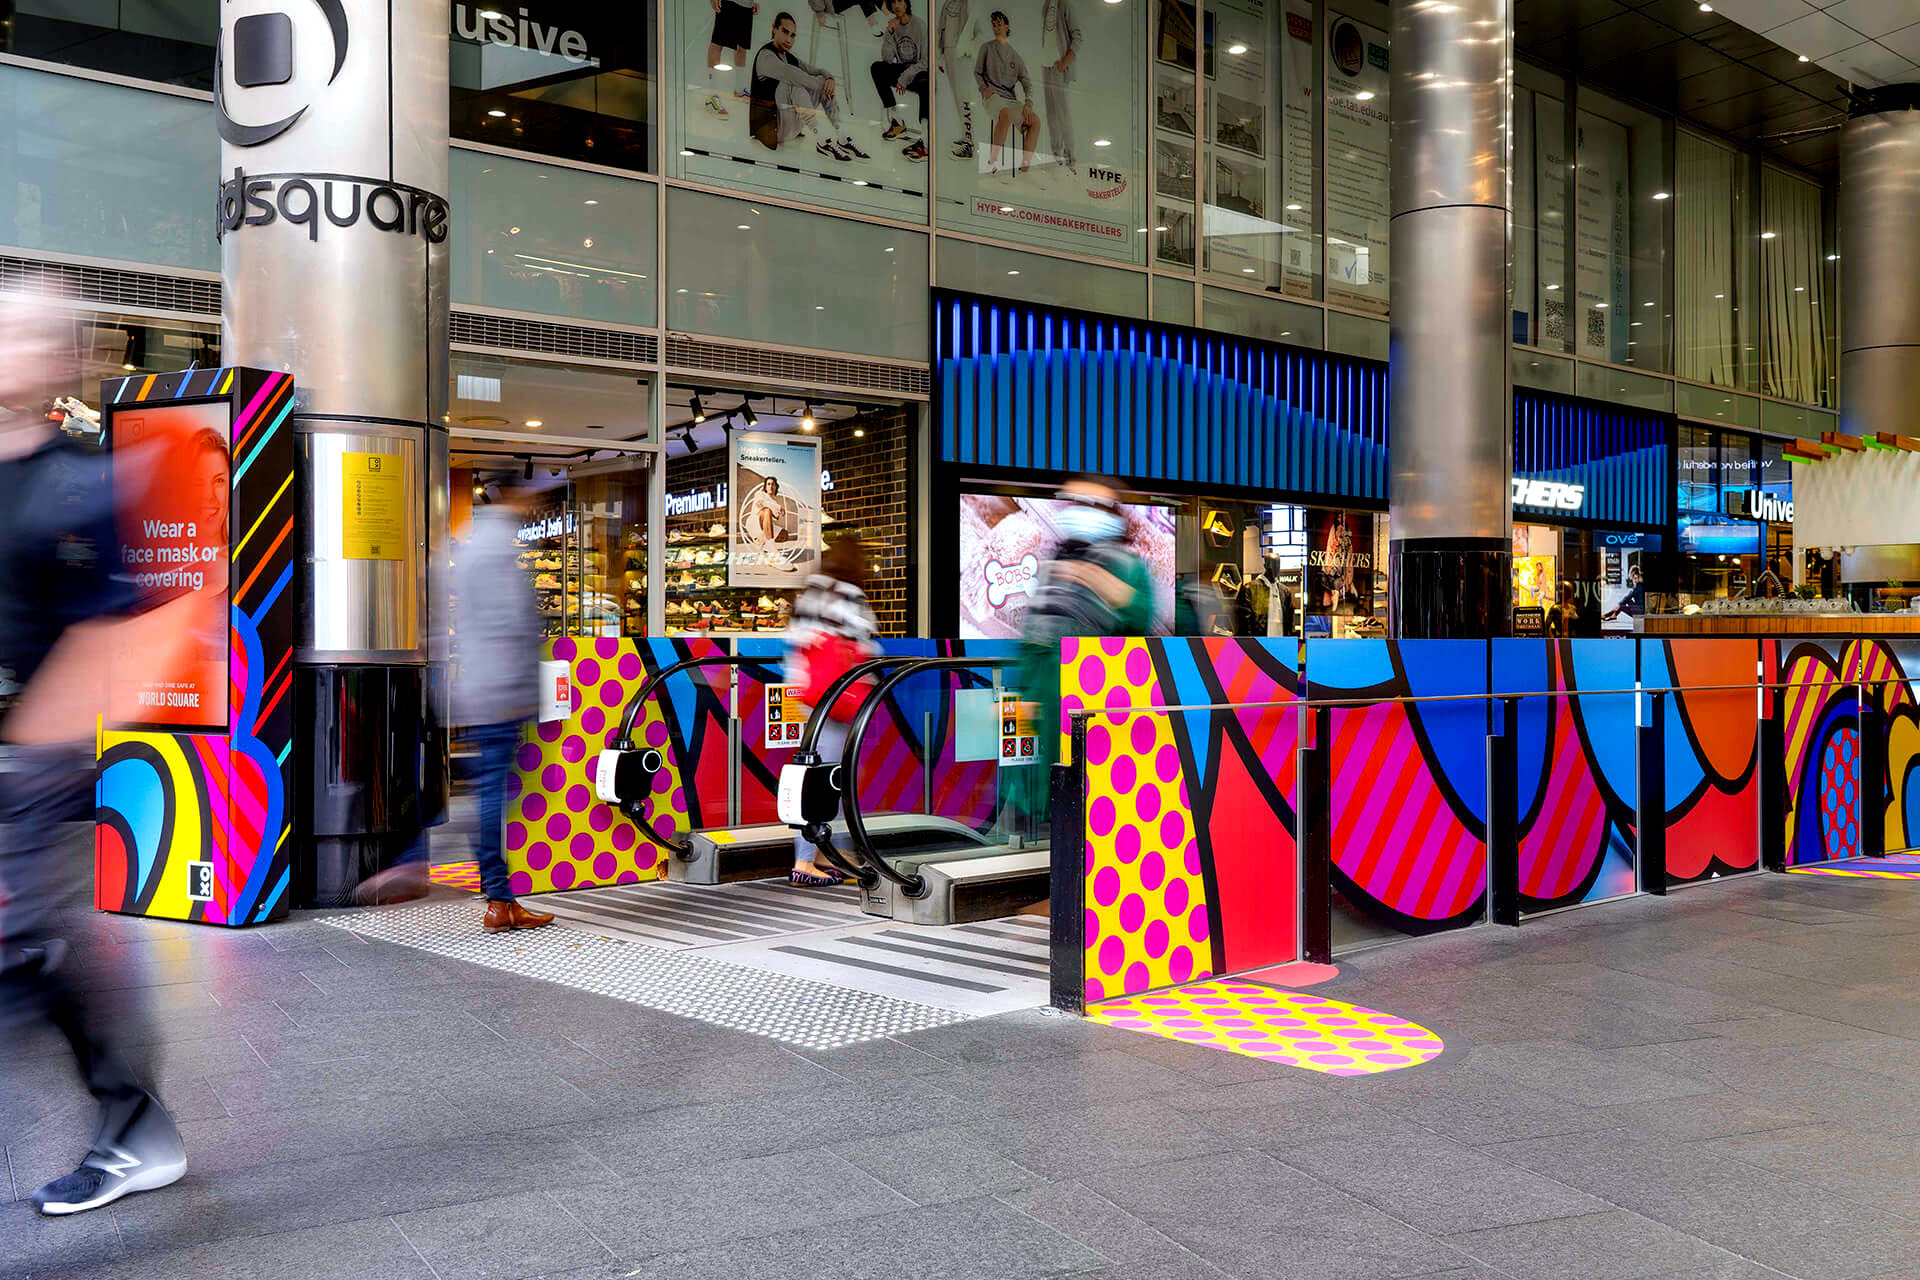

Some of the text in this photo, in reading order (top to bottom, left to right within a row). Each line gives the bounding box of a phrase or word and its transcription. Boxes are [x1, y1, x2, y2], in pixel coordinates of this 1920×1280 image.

[456, 3, 600, 68] usive.
[1089, 167, 1122, 183] HYPE
[665, 488, 715, 517] Premium.
[1751, 489, 1794, 523] Unive
[143, 520, 196, 539] Wear a
[121, 543, 219, 563] face mask or
[1309, 550, 1371, 568] SKECHERS
[136, 567, 204, 591] covering
[994, 566, 1032, 586] BOBS
[137, 691, 200, 708] WORLD SQUARE
